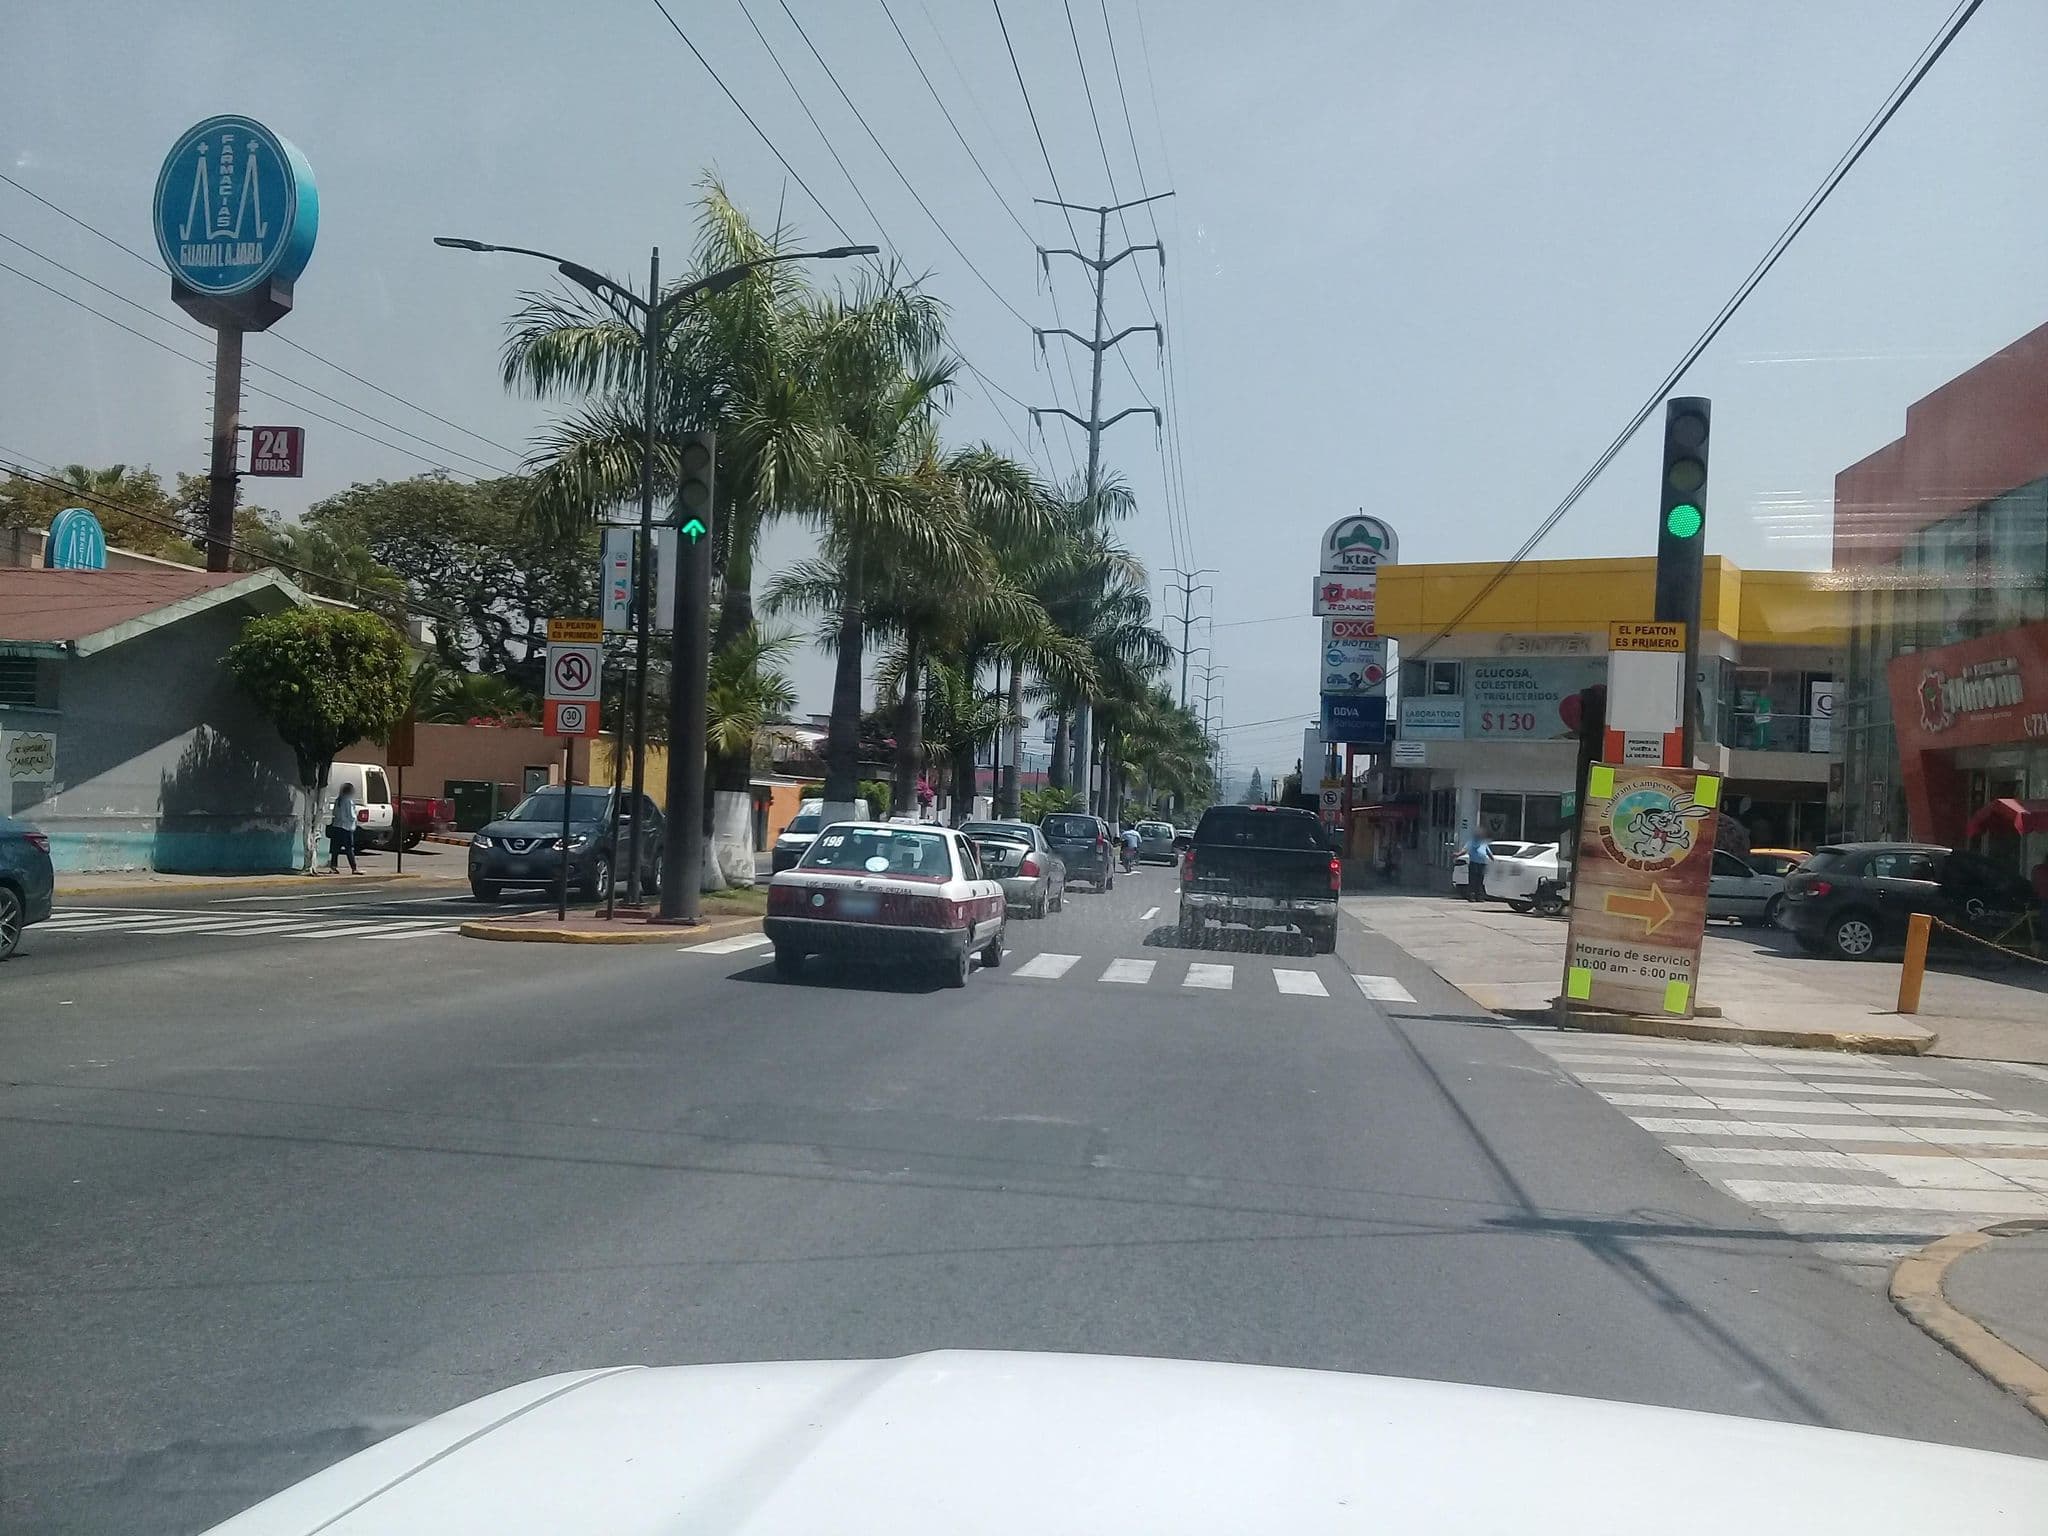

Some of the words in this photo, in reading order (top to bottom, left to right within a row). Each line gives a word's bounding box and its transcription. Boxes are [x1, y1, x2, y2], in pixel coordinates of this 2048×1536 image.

[216, 134, 234, 227] FARMACIAS
[180, 242, 263, 267] GUADALAJARA
[258, 430, 289, 459] 24
[255, 458, 291, 472] HORAS
[1342, 552, 1376, 565] Ixtac
[563, 632, 599, 641] PRIMERO
[1619, 625, 1632, 636] EL
[1634, 626, 1677, 636] PEATON
[1615, 637, 1629, 648] ES
[1631, 638, 1680, 649] PRIMERO
[1475, 668, 1533, 680] GLUCOSA,
[1474, 680, 1539, 690] COLESTEROL
[566, 710, 577, 720] 30
[1405, 710, 1461, 719] LABORATORIO
[1632, 780, 1678, 794] Campestre
[821, 835, 846, 848] 198
[1575, 942, 1621, 959] Horario
[1624, 949, 1639, 961] de
[1643, 953, 1691, 967] servicio
[1575, 958, 1607, 971] 10:00
[1610, 963, 1629, 975] am
[1640, 966, 1666, 979] 6:00
[1669, 971, 1689, 981] pm
